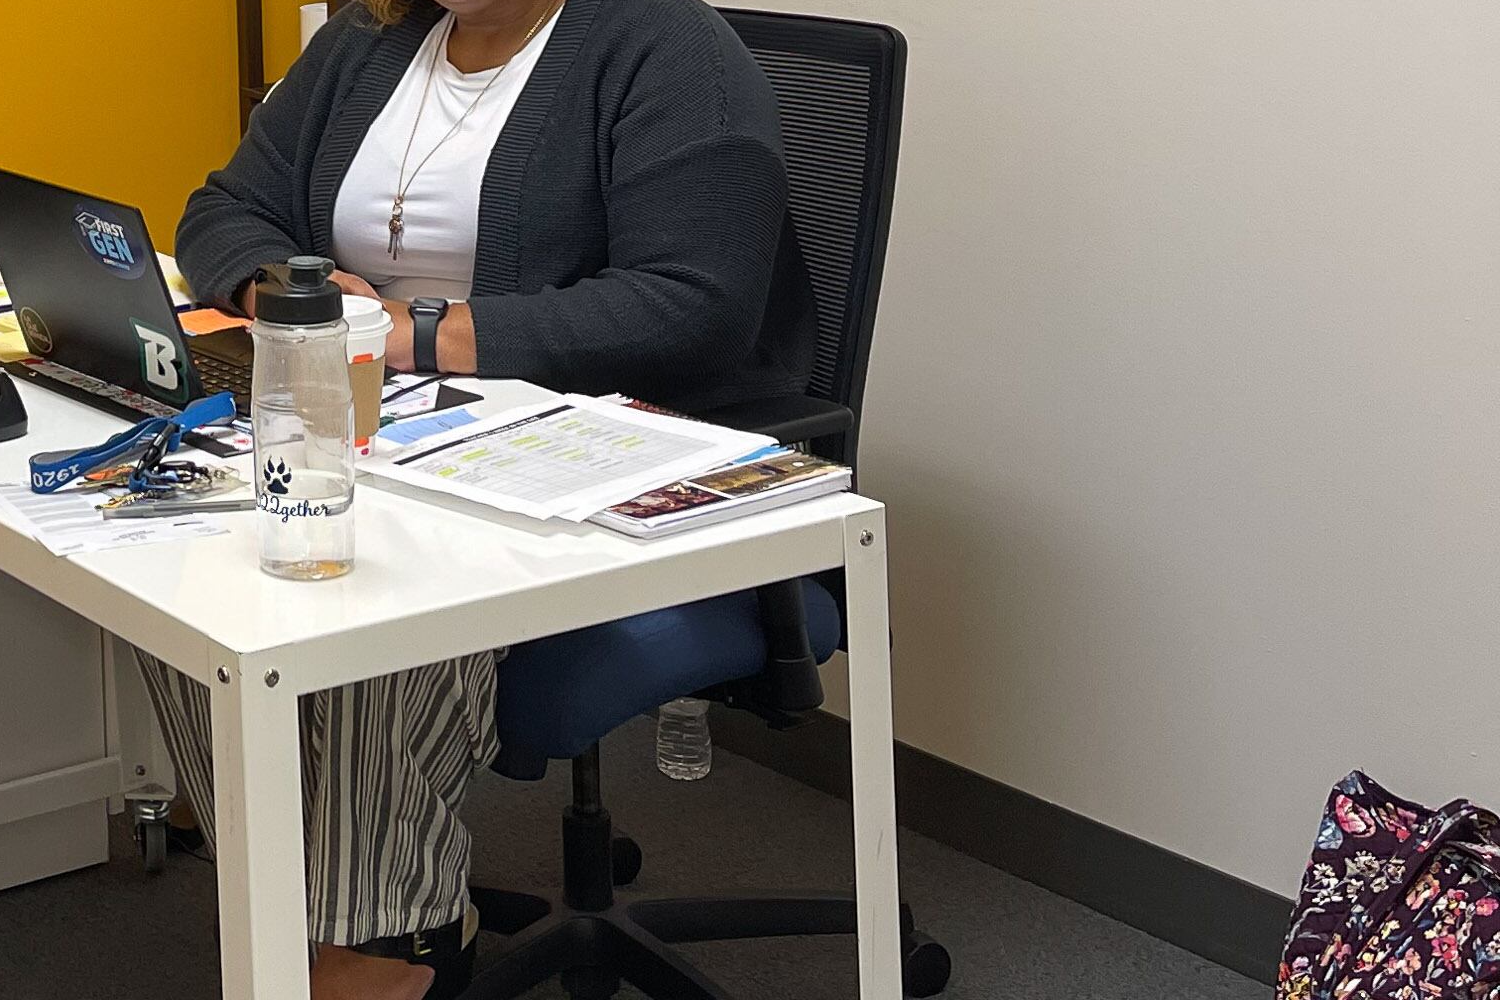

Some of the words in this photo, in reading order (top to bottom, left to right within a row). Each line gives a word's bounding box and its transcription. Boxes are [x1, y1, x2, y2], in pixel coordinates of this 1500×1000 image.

[94, 219, 124, 238] FIRST
[88, 230, 134, 264] GEN
[135, 324, 178, 390] B
[32, 463, 80, 488] 1920
